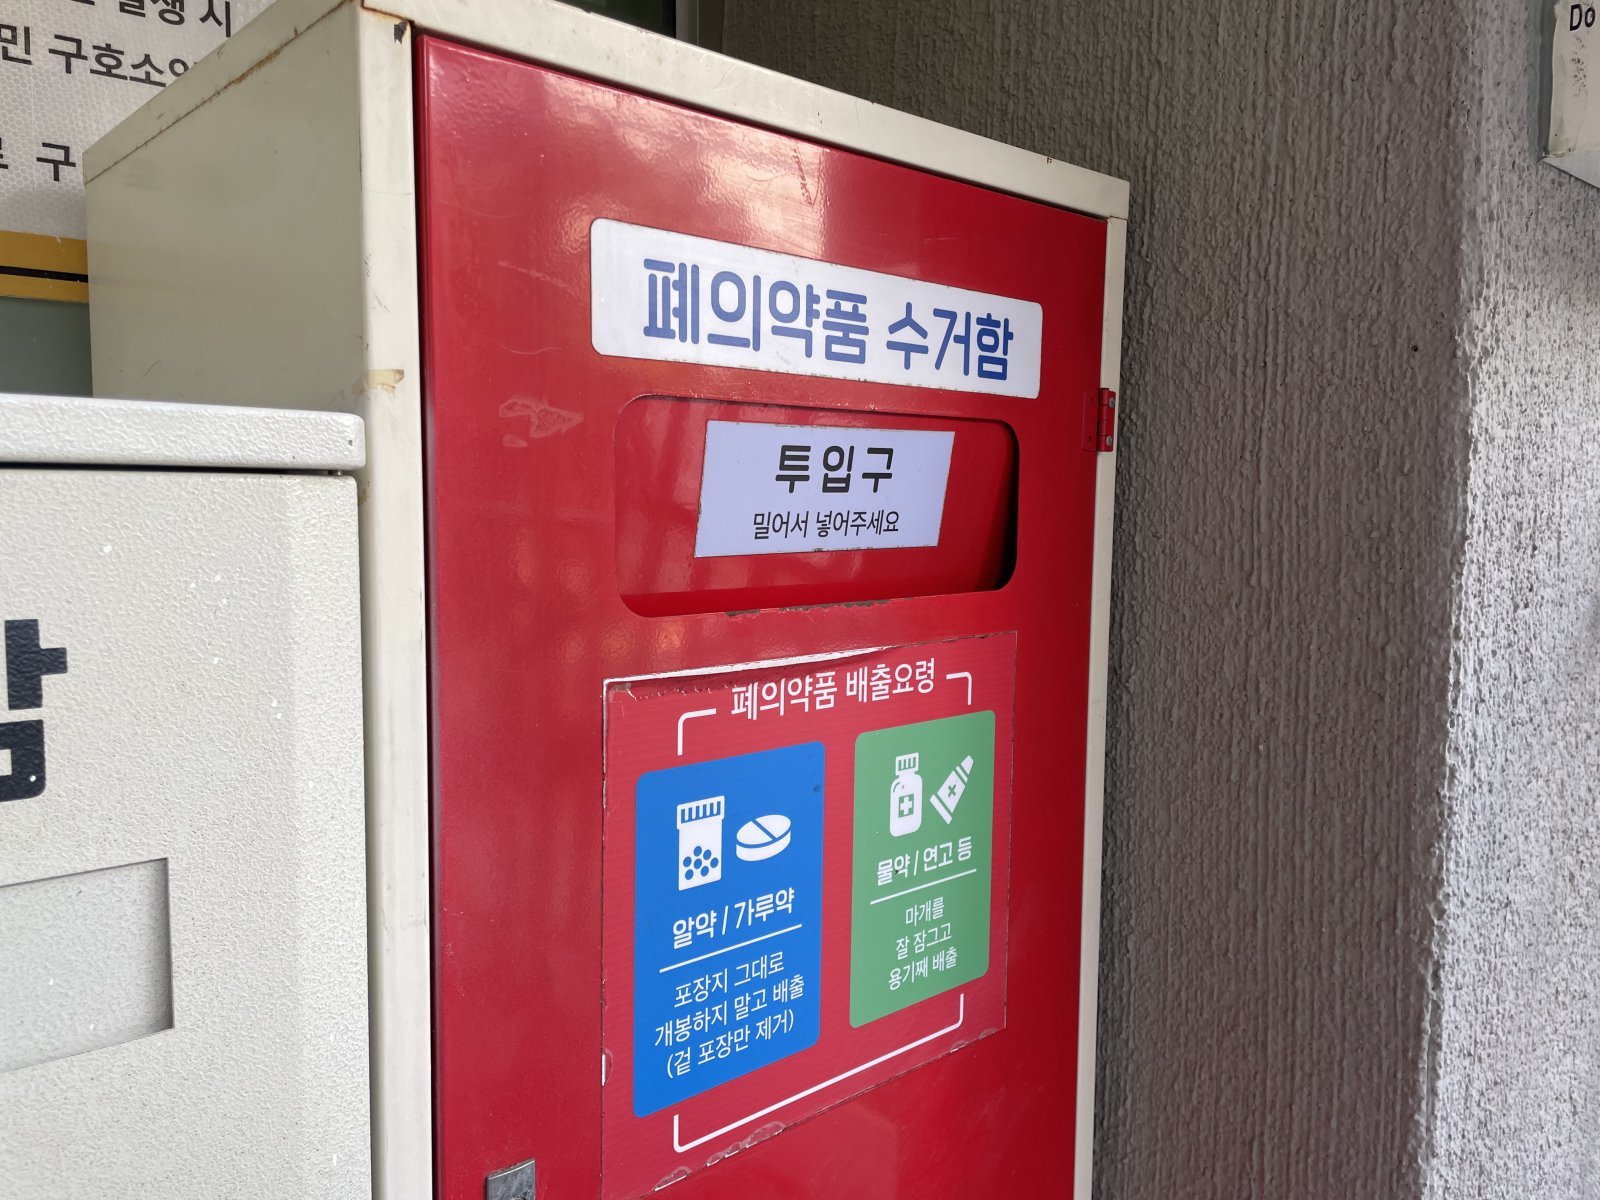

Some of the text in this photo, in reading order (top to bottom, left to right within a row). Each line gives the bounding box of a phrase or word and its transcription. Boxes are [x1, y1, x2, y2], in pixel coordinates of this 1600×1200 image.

[199, 0, 231, 38] 시
[643, 257, 1014, 381] 폐의약품 수거함
[775, 444, 894, 494] 투입구
[753, 509, 900, 540] 밀어서 넣어주세요
[731, 657, 935, 721] 폐의약품 배출요령
[877, 853, 911, 886] 물약
[923, 841, 953, 873] 연고
[957, 836, 972, 861] 등
[672, 909, 718, 950] 알약
[733, 887, 795, 929] 가루약
[905, 896, 945, 927] 마개를
[895, 922, 952, 961] 잘 잠그고
[673, 951, 785, 1009] 포장지 그대로
[888, 946, 958, 991] 용기째 배출
[654, 974, 805, 1047] 개봉하지 말고 배출
[666, 1008, 794, 1079] (겉 포장만 제거)
